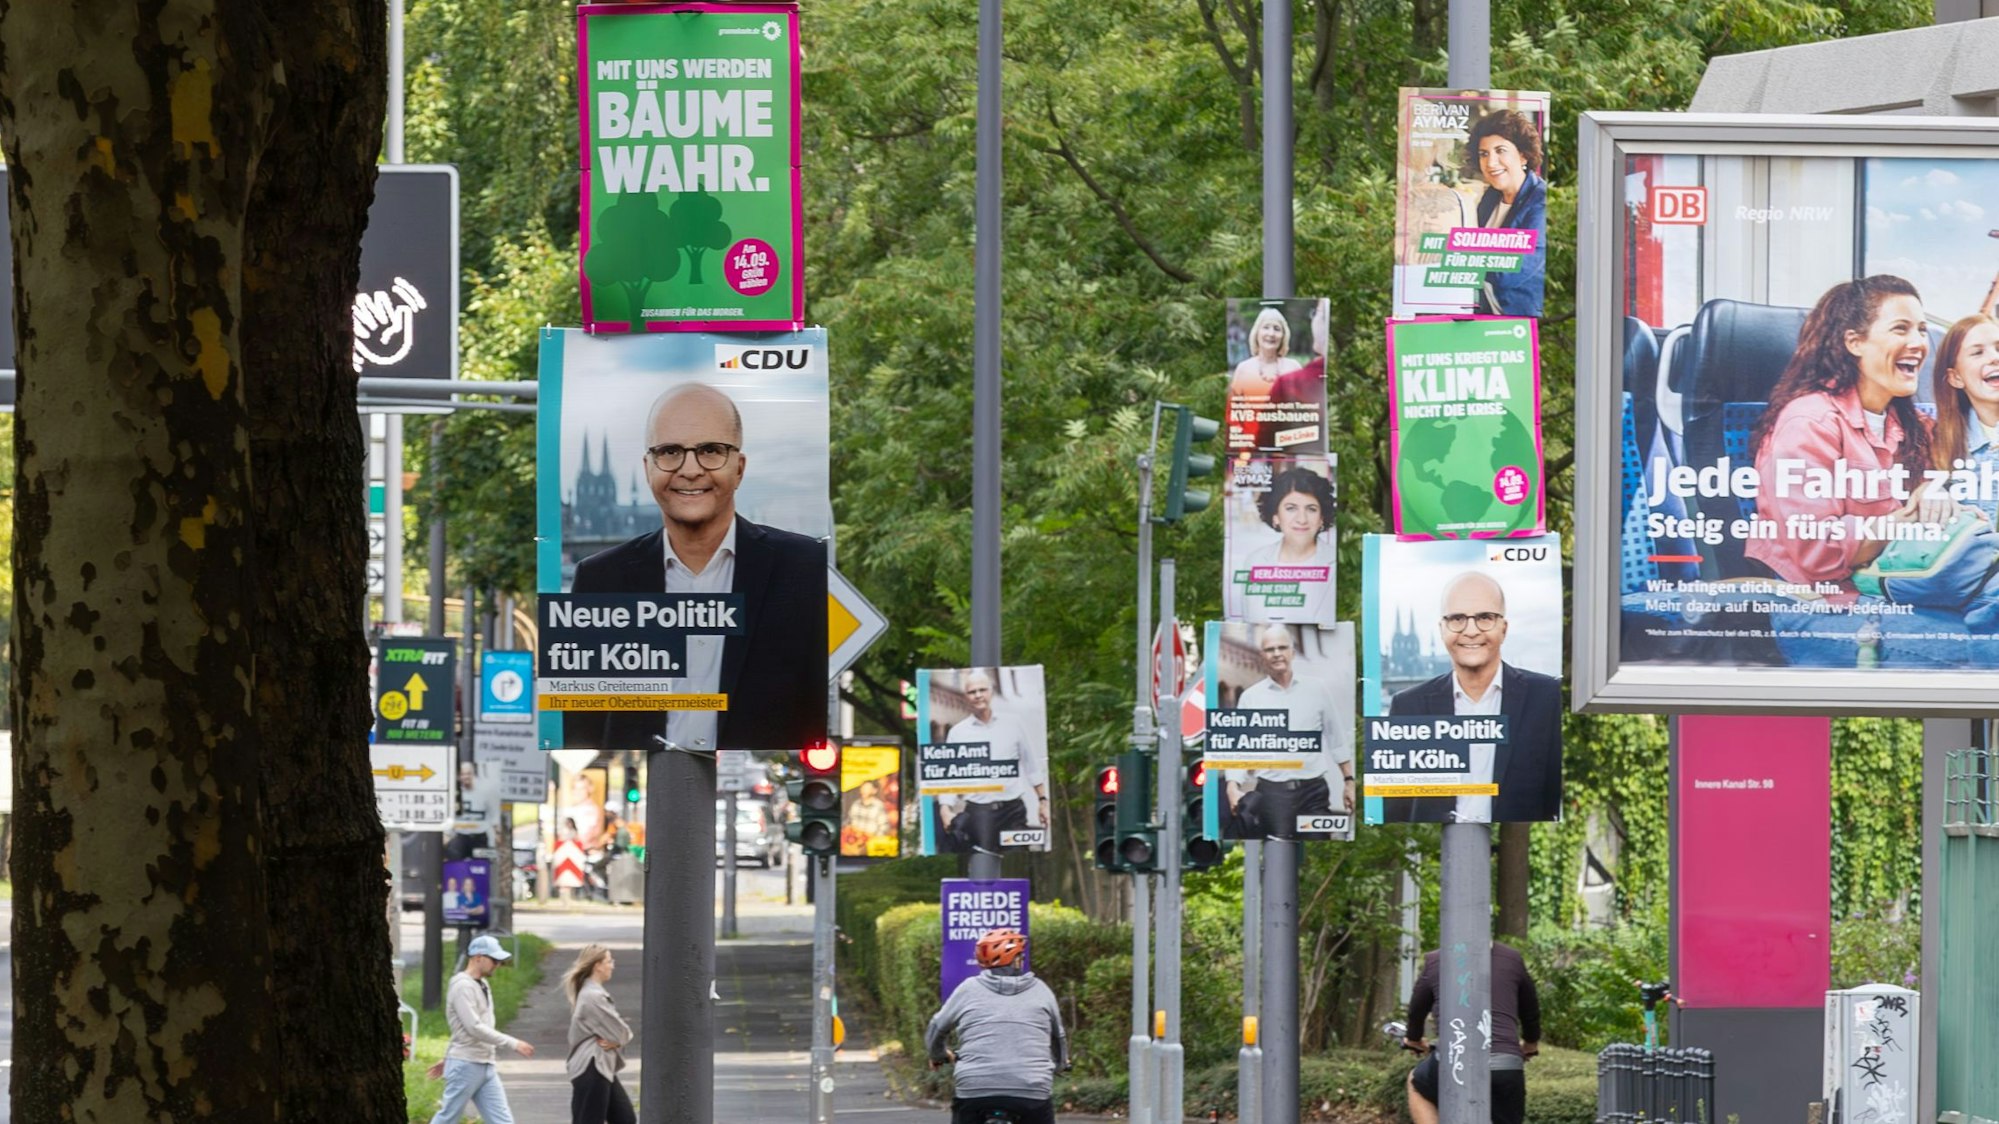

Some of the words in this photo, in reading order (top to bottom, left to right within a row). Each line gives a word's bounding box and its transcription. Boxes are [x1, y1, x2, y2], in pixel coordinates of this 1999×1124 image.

[597, 60, 632, 80] MIT
[636, 59, 678, 79] UNS
[683, 59, 772, 78] WERDEN
[598, 80, 773, 139] BÄUME
[1412, 116, 1469, 129] AYMAZ
[598, 145, 770, 193] WAHR.
[1658, 192, 1701, 217] DB
[1735, 204, 1783, 223] Regio
[1789, 205, 1833, 221] NRW
[1423, 237, 1445, 249] MIT
[1452, 231, 1532, 249] SOLIDARITÄT.
[733, 252, 770, 269] 14.09.
[1444, 252, 1467, 267] FÜR
[1467, 255, 1486, 267] DIE
[1486, 255, 1519, 268] STADT
[1428, 271, 1449, 284] MIT
[1449, 272, 1480, 285] HERZ.
[681, 307, 696, 317] FÜR
[697, 308, 712, 317] DAS
[741, 349, 808, 370] CDU
[1401, 354, 1424, 367] MIT
[1426, 353, 1452, 366] UNS
[1454, 351, 1499, 365] KRIEGT
[1500, 350, 1525, 363] DAS
[1402, 366, 1511, 403] KLIMA
[1230, 409, 1255, 422] KVB
[1256, 410, 1319, 422] ausbauen
[1404, 405, 1441, 418] NICHT
[1443, 403, 1465, 417] DIE
[1467, 402, 1507, 416] KRISE.
[1279, 435, 1292, 443] Die
[1233, 474, 1272, 485] AYMAZ
[1648, 456, 1760, 506] Jede
[1775, 458, 1909, 500] Fahrt
[1647, 512, 1724, 545] Steig
[1730, 514, 1778, 539] ein
[1786, 515, 1845, 541] fürs
[1504, 548, 1546, 561] CDU
[1647, 579, 1674, 592] Wir
[1678, 581, 1736, 596] bringen
[1740, 581, 1772, 593] dich
[1776, 583, 1812, 596] gern
[1815, 583, 1843, 595] hin.
[549, 601, 630, 627] Neue
[637, 600, 737, 627] Politik
[1645, 600, 1681, 612] Mehr
[1686, 601, 1720, 612] dazu
[1725, 601, 1748, 612] auf
[385, 648, 448, 665] XTRAFIT
[548, 642, 594, 670] für
[601, 642, 680, 670] Köln.
[550, 681, 595, 692] Markus
[598, 680, 668, 692] Greitemann
[550, 697, 567, 708] Ihr
[571, 698, 605, 708] neuer
[608, 696, 723, 711] Oberbürgermeister
[1210, 712, 1247, 727] Kein
[1249, 712, 1286, 727] Amt
[1371, 721, 1430, 741] Neue
[1434, 720, 1504, 740] Politik
[924, 746, 955, 759] Kein
[957, 744, 988, 758] Amt
[1210, 734, 1235, 749] für
[1237, 734, 1319, 752] Anfänger.
[1371, 751, 1406, 770] für
[1409, 750, 1466, 770] Köln.
[924, 764, 945, 778] für
[947, 763, 1017, 778] Anfänger.
[1312, 819, 1346, 830] CDU
[1013, 833, 1042, 843] CDU
[948, 891, 1021, 910] FRIEDE
[948, 910, 1021, 927] FREUDE
